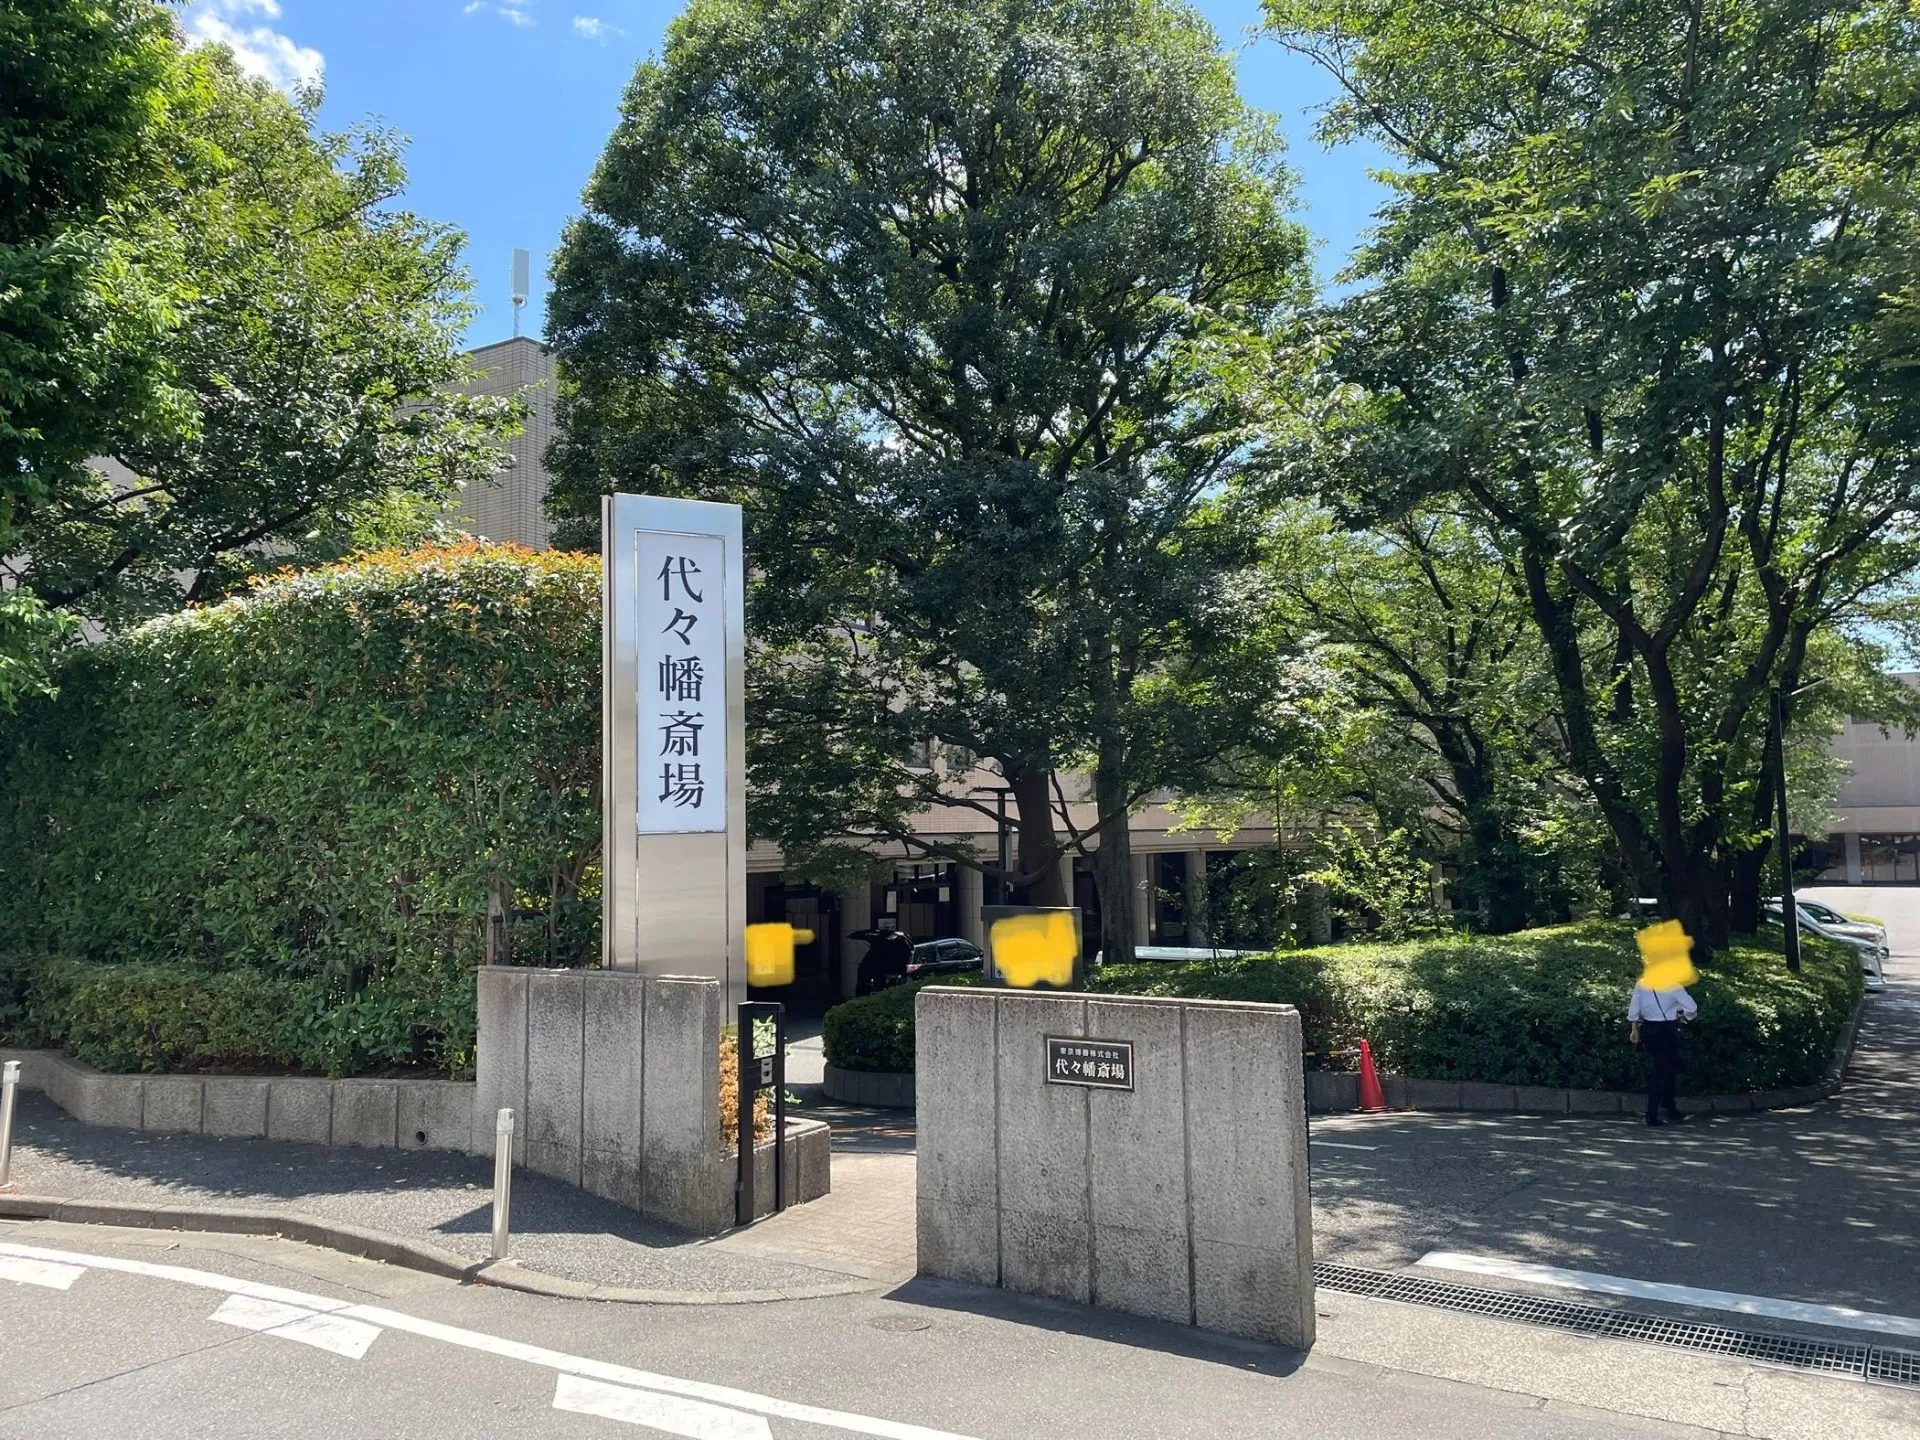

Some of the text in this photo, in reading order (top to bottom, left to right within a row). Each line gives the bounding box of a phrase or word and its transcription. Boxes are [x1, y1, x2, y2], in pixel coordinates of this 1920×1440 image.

[657, 555, 704, 808] 代々幡斎場
[1056, 1059, 1124, 1079] 代々幡斎場
